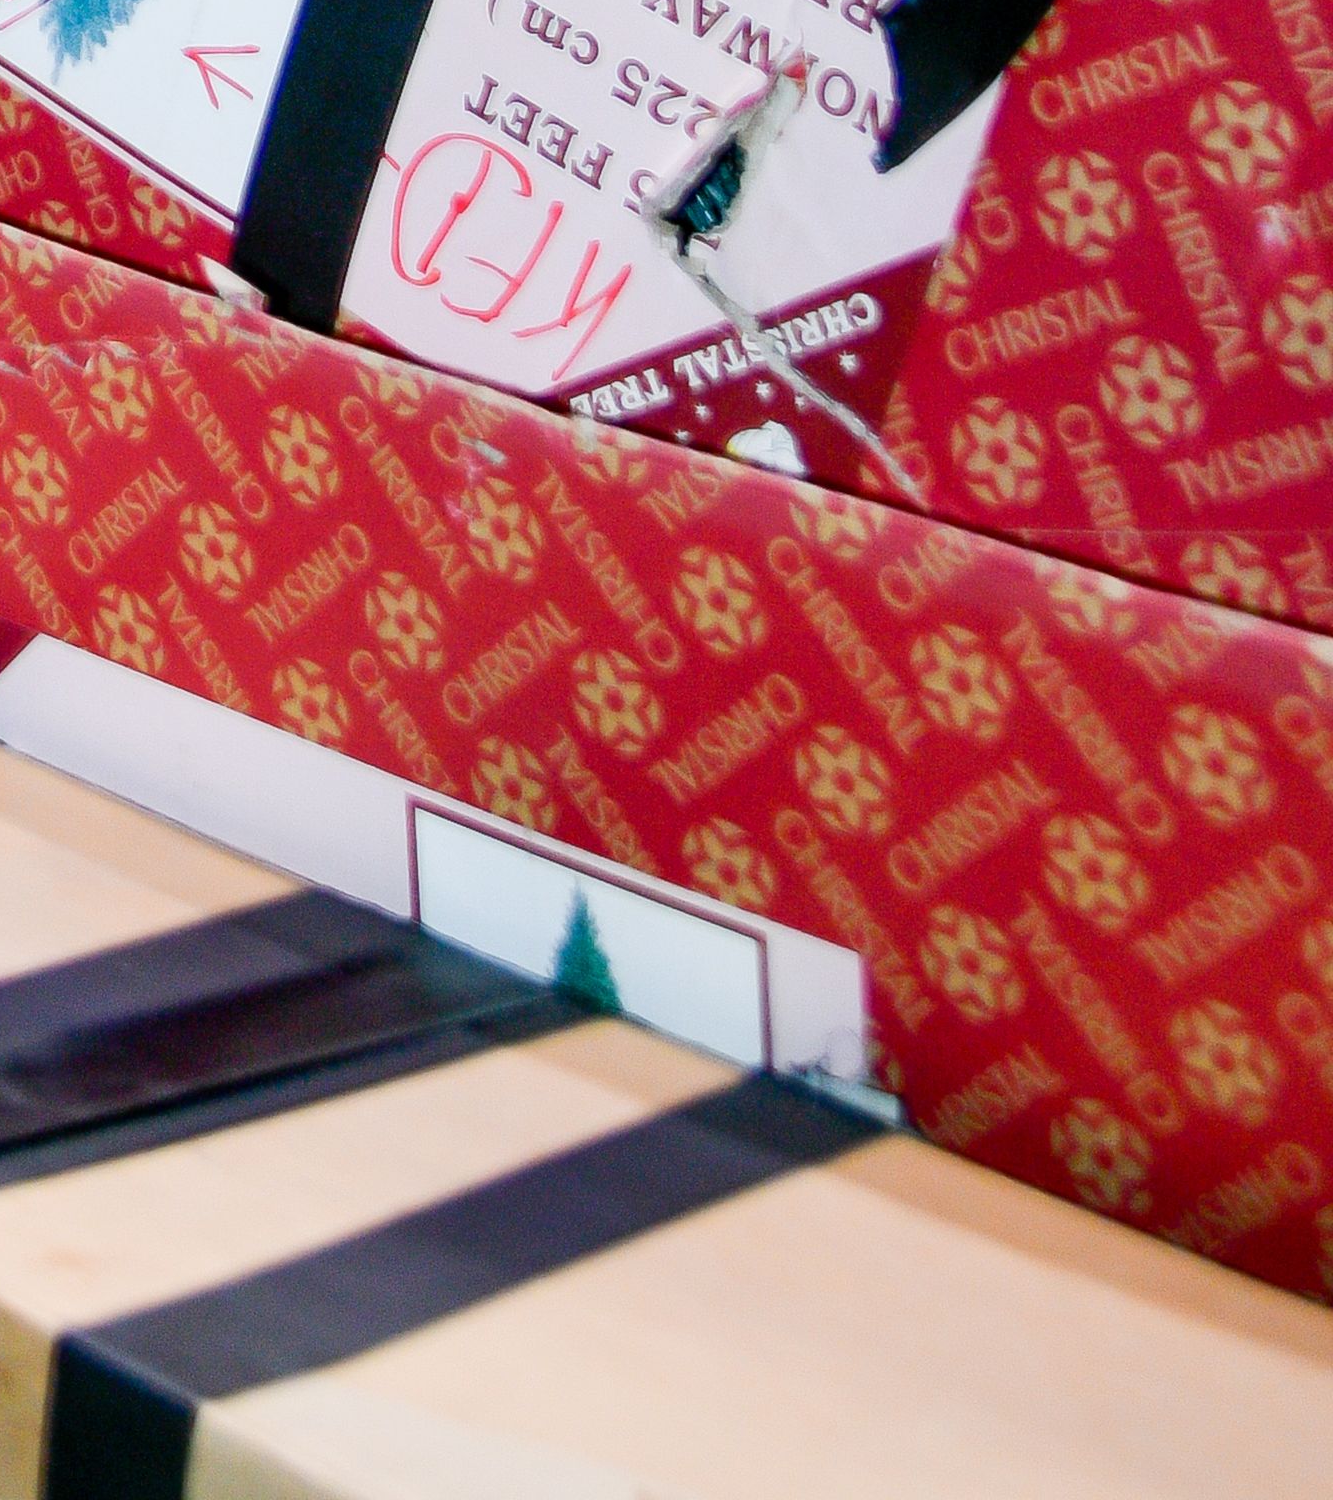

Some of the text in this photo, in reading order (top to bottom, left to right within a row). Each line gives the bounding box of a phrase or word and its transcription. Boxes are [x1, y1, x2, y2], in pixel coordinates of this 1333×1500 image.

[463, 72, 615, 192] FEET
[1033, 25, 1231, 129] CHRISTAL
[945, 279, 1139, 375] CHRISTAL
[1143, 151, 1263, 384] CHRISTAL
[68, 457, 186, 575] CHRISTAL
[339, 395, 475, 598] CHRISTAL
[244, 523, 371, 644] CHRISTAL
[533, 458, 683, 674] CHRISTAL
[442, 598, 584, 727] CHRISTAL
